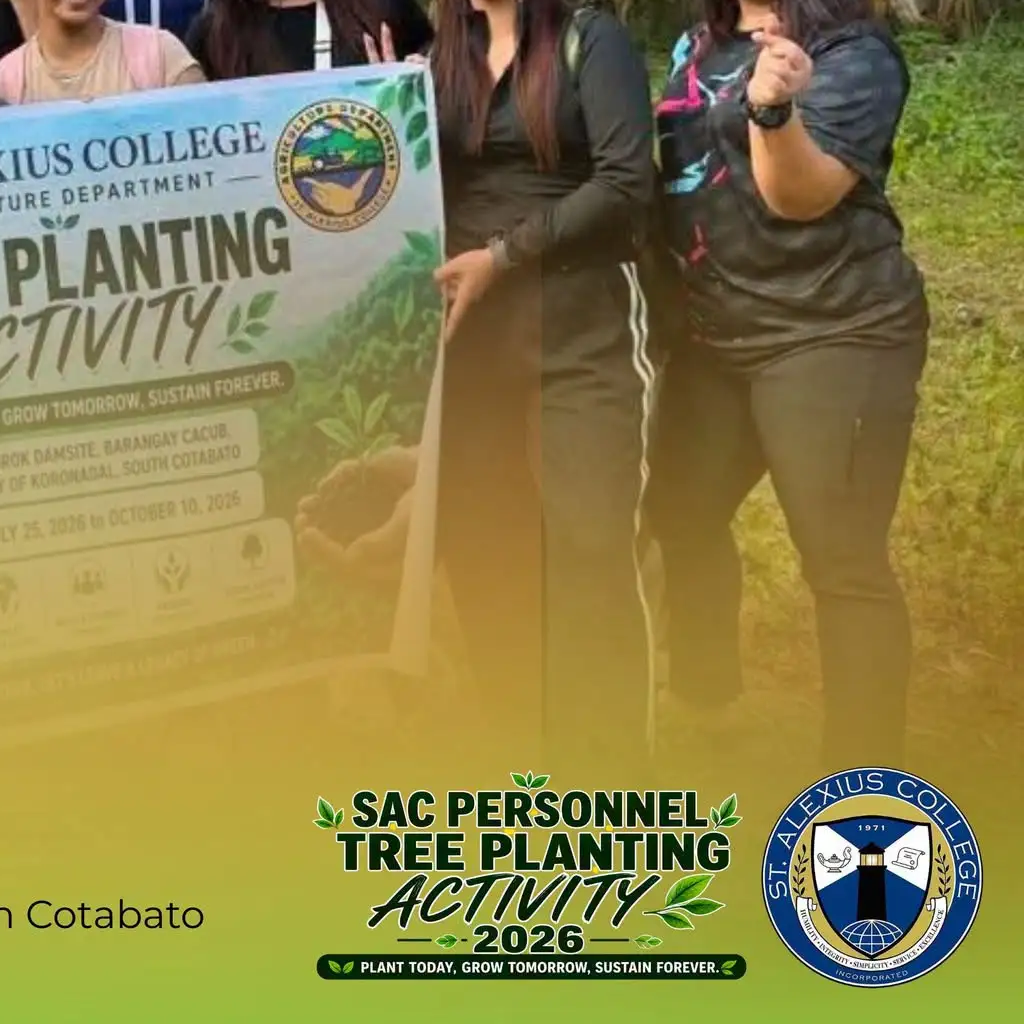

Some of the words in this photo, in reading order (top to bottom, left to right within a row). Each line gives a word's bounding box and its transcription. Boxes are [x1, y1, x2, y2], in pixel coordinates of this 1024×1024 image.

[82, 120, 266, 172] COLLEGE
[61, 170, 215, 206] DEPARTMENT
[3, 206, 292, 308] PLANTING
[2, 402, 49, 427] GROW
[53, 392, 146, 420] TOMORROW,
[148, 383, 212, 408] SUSTAIN
[215, 371, 285, 399] FOREVER.
[8, 475, 27, 494] OF
[122, 454, 170, 477] SOUTH
[171, 444, 242, 471] COTABATO
[104, 432, 178, 457] BARANGAY
[22, 519, 45, 541] 25,
[48, 512, 86, 536] 2026
[89, 510, 107, 529] to
[109, 500, 176, 528] OCTOBER
[178, 495, 204, 518] 10,
[206, 489, 242, 512] 2026
